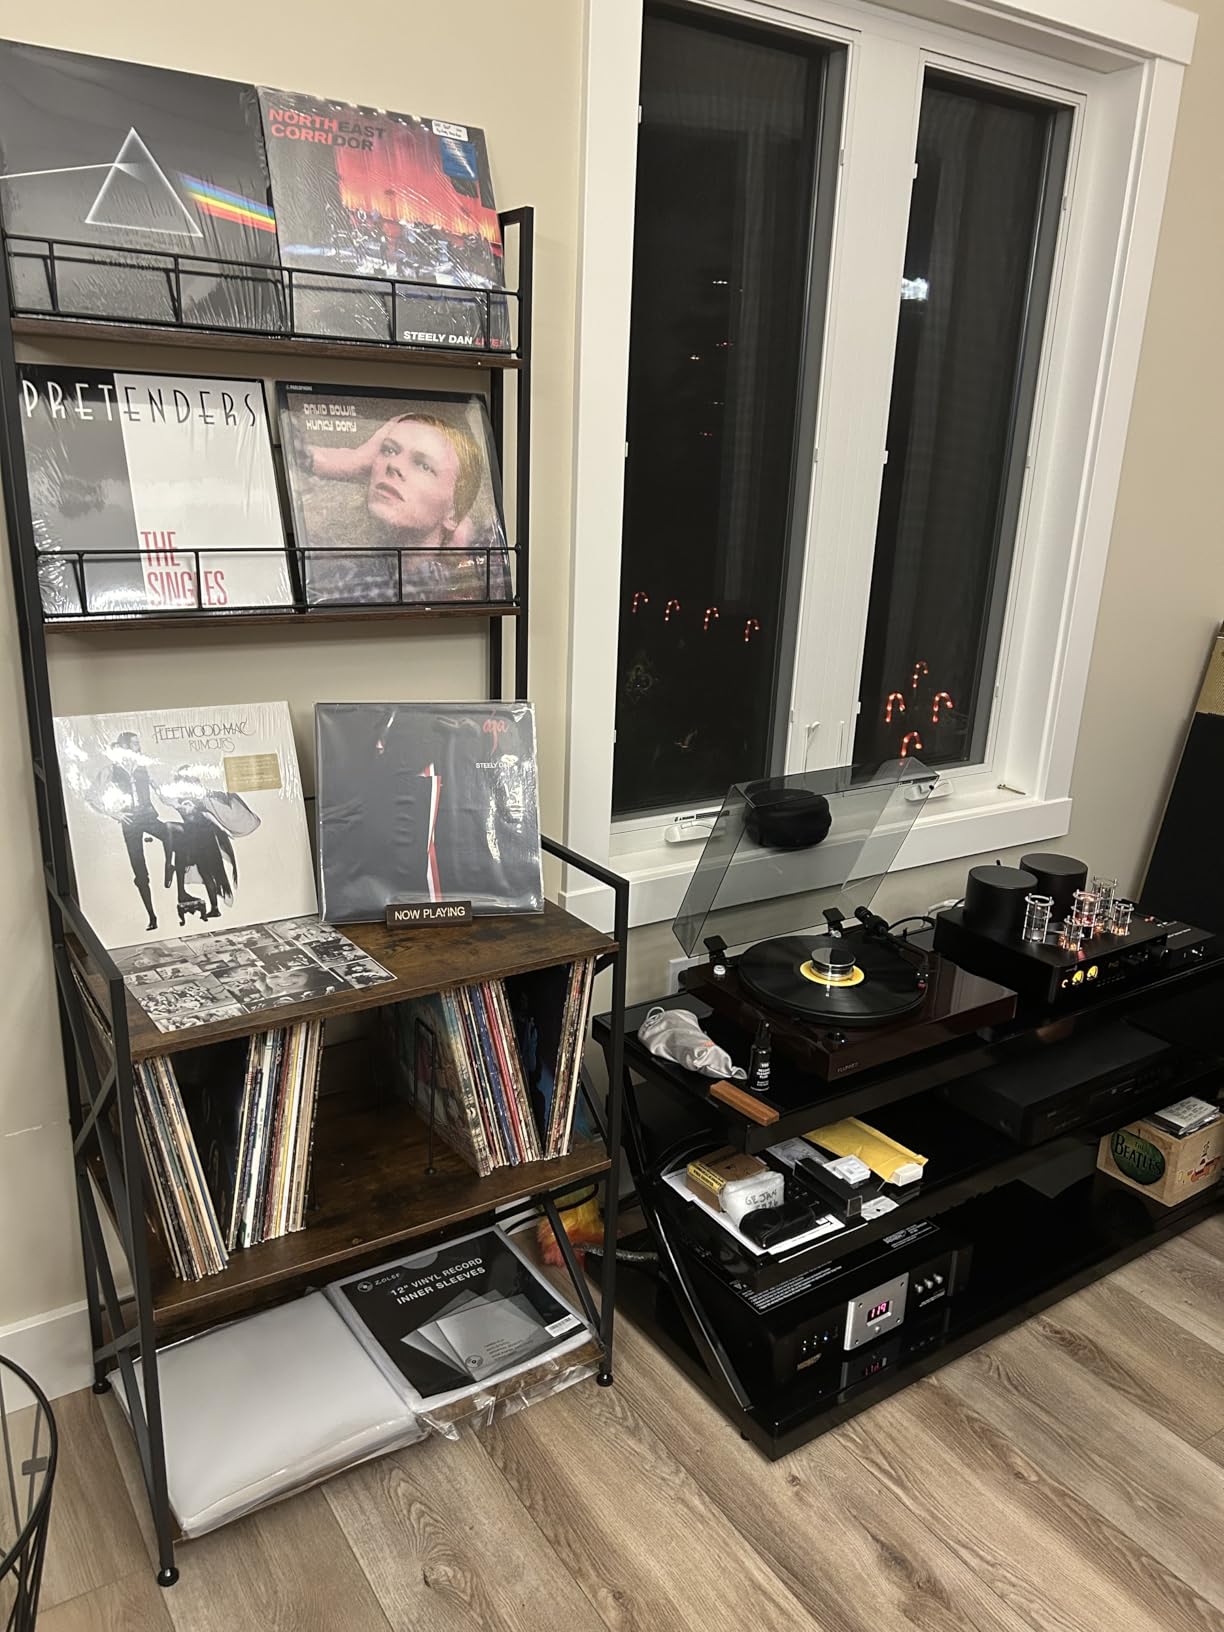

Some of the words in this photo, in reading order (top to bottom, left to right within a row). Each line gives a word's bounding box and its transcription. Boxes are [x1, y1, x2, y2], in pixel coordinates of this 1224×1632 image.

[268, 108, 384, 139] NORTHEAST
[271, 123, 374, 152] CORRIDOR
[403, 330, 446, 343] STEELY
[448, 334, 473, 345] DAN
[474, 336, 504, 349] LIE!
[22, 380, 257, 427] PRETENDERS
[303, 403, 328, 415] DAVID
[328, 404, 357, 417] BOWIE
[305, 419, 333, 432] HUNKY
[335, 420, 357, 433] DORY
[140, 531, 181, 567] THE
[147, 570, 229, 607] SINGES
[152, 724, 220, 744] FLEETWOOD
[188, 737, 235, 753] RUMOURS
[394, 909, 420, 921] NOW
[423, 906, 466, 919] PLAYING
[1114, 1133, 1163, 1175] BEATLES
[390, 1284, 409, 1297] 12"
[411, 1272, 442, 1289] VINYL
[442, 1257, 483, 1277] RECORD
[396, 1286, 434, 1305] INNER
[435, 1266, 486, 1290] SLEEVES
[871, 1302, 887, 1318] 119
